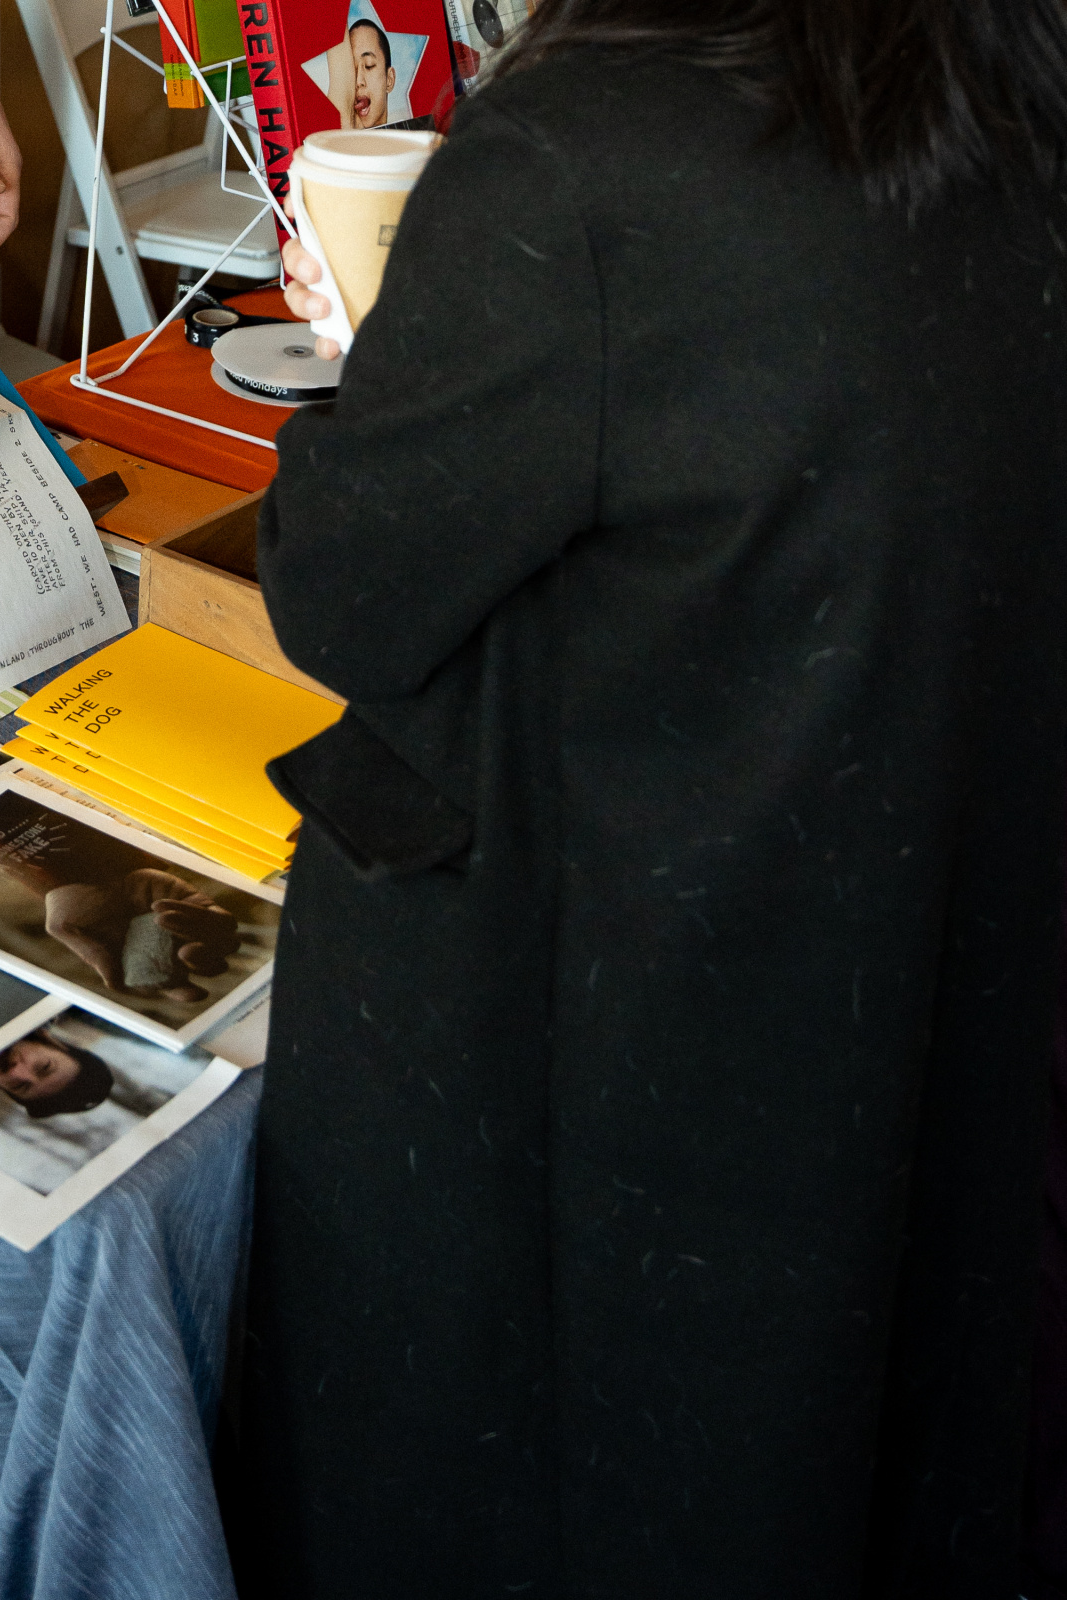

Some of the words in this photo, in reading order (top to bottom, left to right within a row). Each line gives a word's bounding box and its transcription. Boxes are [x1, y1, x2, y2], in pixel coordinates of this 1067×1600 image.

[241, 2, 279, 88] REN
[258, 107, 297, 231] HAN
[192, 332, 199, 343] 3
[244, 377, 288, 396] Mondays
[21, 450, 48, 488] BESIDE
[4, 506, 15, 519] BY
[48, 492, 69, 520] CAMP
[0, 513, 14, 532] THE
[13, 534, 23, 547] ON
[15, 524, 32, 548] MEN
[28, 529, 43, 551] OUR
[37, 532, 52, 556] THIS
[68, 526, 81, 547] HAD
[41, 554, 59, 589] AFTER
[51, 558, 66, 587] FROM
[80, 555, 90, 573] WE
[38, 567, 52, 592] HAVE
[91, 577, 106, 617] WEST.
[79, 618, 95, 632] THE
[44, 668, 113, 716] WALKING
[63, 699, 99, 724] THE
[84, 706, 122, 734] DOG
[8, 836, 51, 863] FAKE
